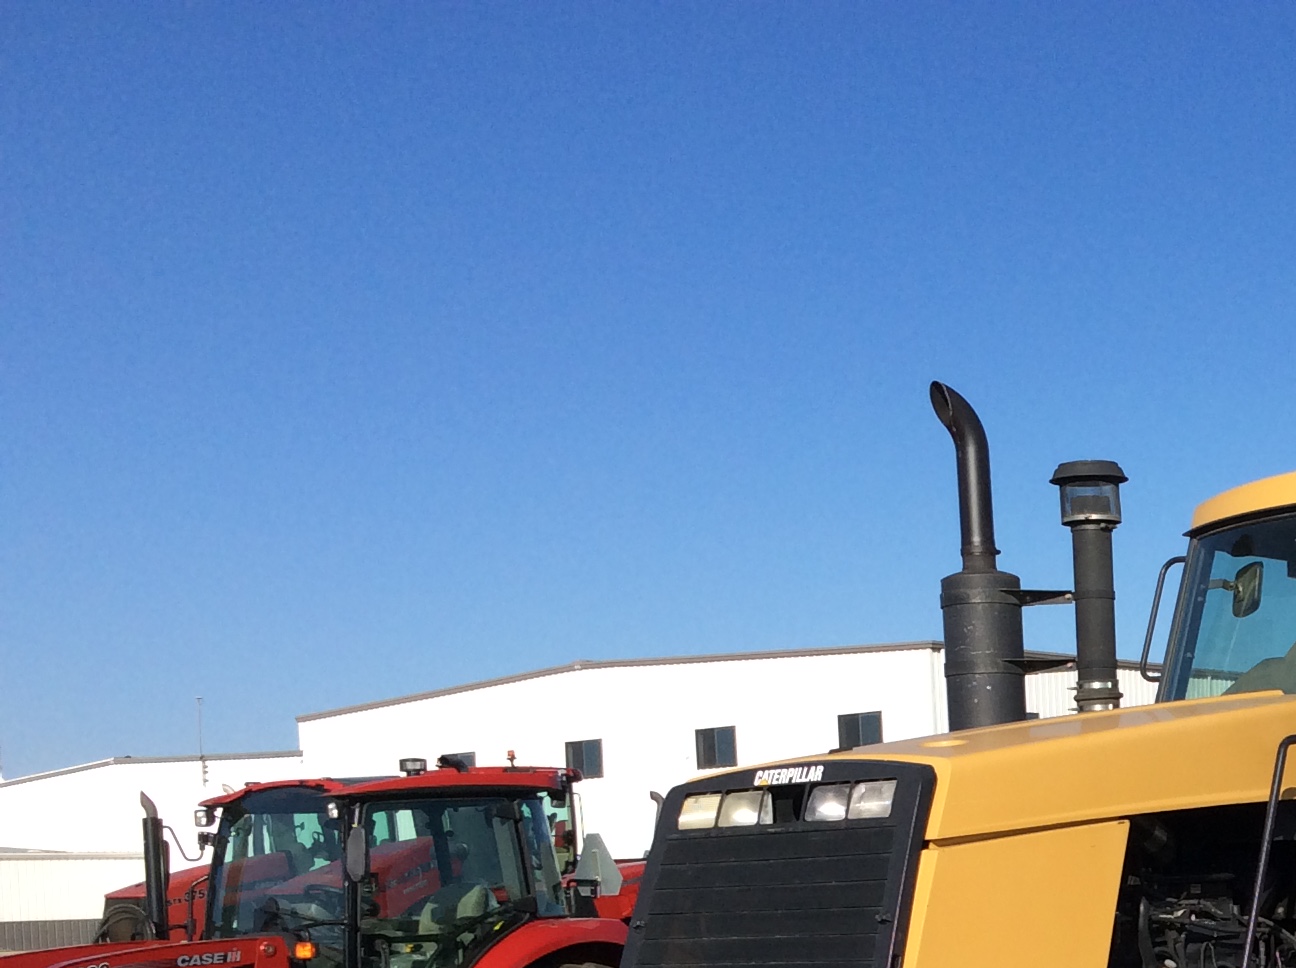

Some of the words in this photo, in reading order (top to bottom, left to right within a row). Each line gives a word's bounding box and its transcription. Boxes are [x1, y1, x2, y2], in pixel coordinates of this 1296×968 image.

[754, 765, 824, 786] CATERPILLAR
[177, 952, 225, 968] CASE
[227, 947, 242, 963] IH
